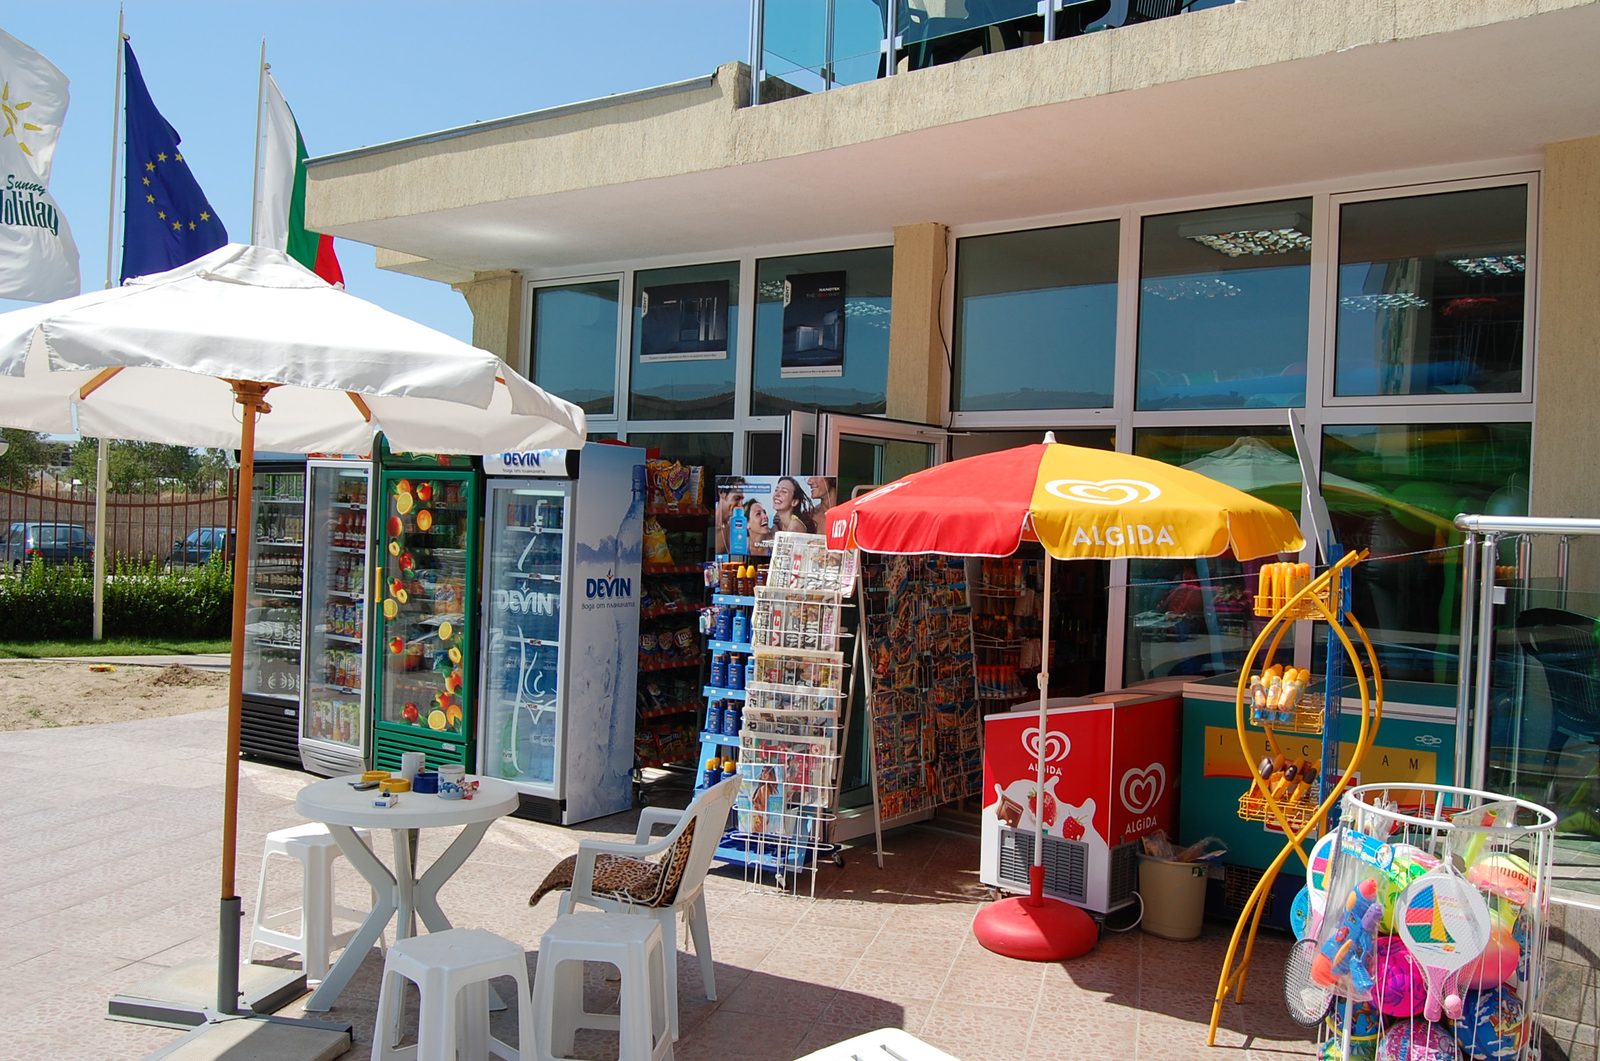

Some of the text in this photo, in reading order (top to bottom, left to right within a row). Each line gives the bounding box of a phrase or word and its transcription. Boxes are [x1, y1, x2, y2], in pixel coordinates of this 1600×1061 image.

[6, 174, 46, 196] Sunny
[503, 452, 541, 467] DEVIN
[586, 578, 632, 598] DEVIN
[496, 589, 554, 616] DEVIN
[1028, 763, 1063, 776] ALIDA
